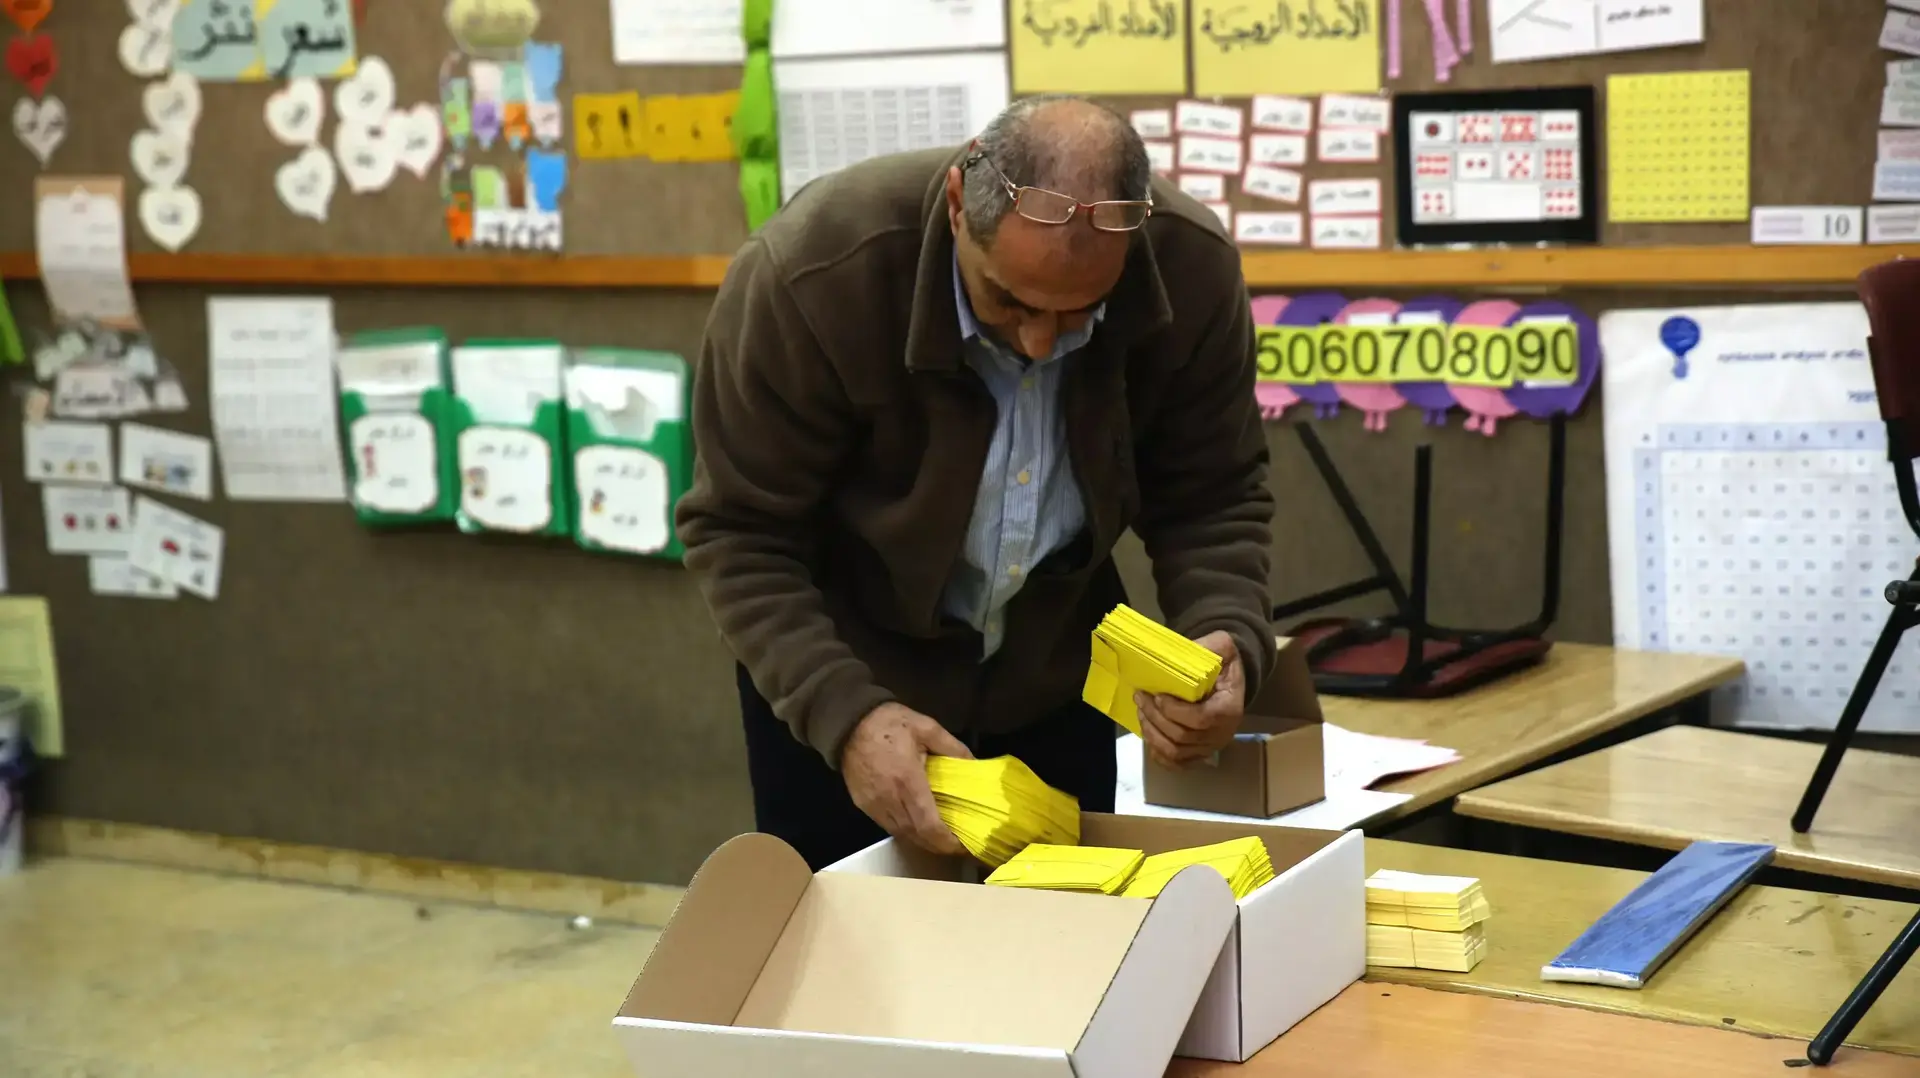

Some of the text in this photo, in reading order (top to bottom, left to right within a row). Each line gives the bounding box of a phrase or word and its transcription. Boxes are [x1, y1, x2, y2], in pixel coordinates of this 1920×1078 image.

[1824, 214, 1850, 237] 10
[1319, 329, 1380, 376] 60
[1382, 327, 1447, 375] 70
[1450, 331, 1512, 380] 80
[1516, 327, 1575, 374] 90
